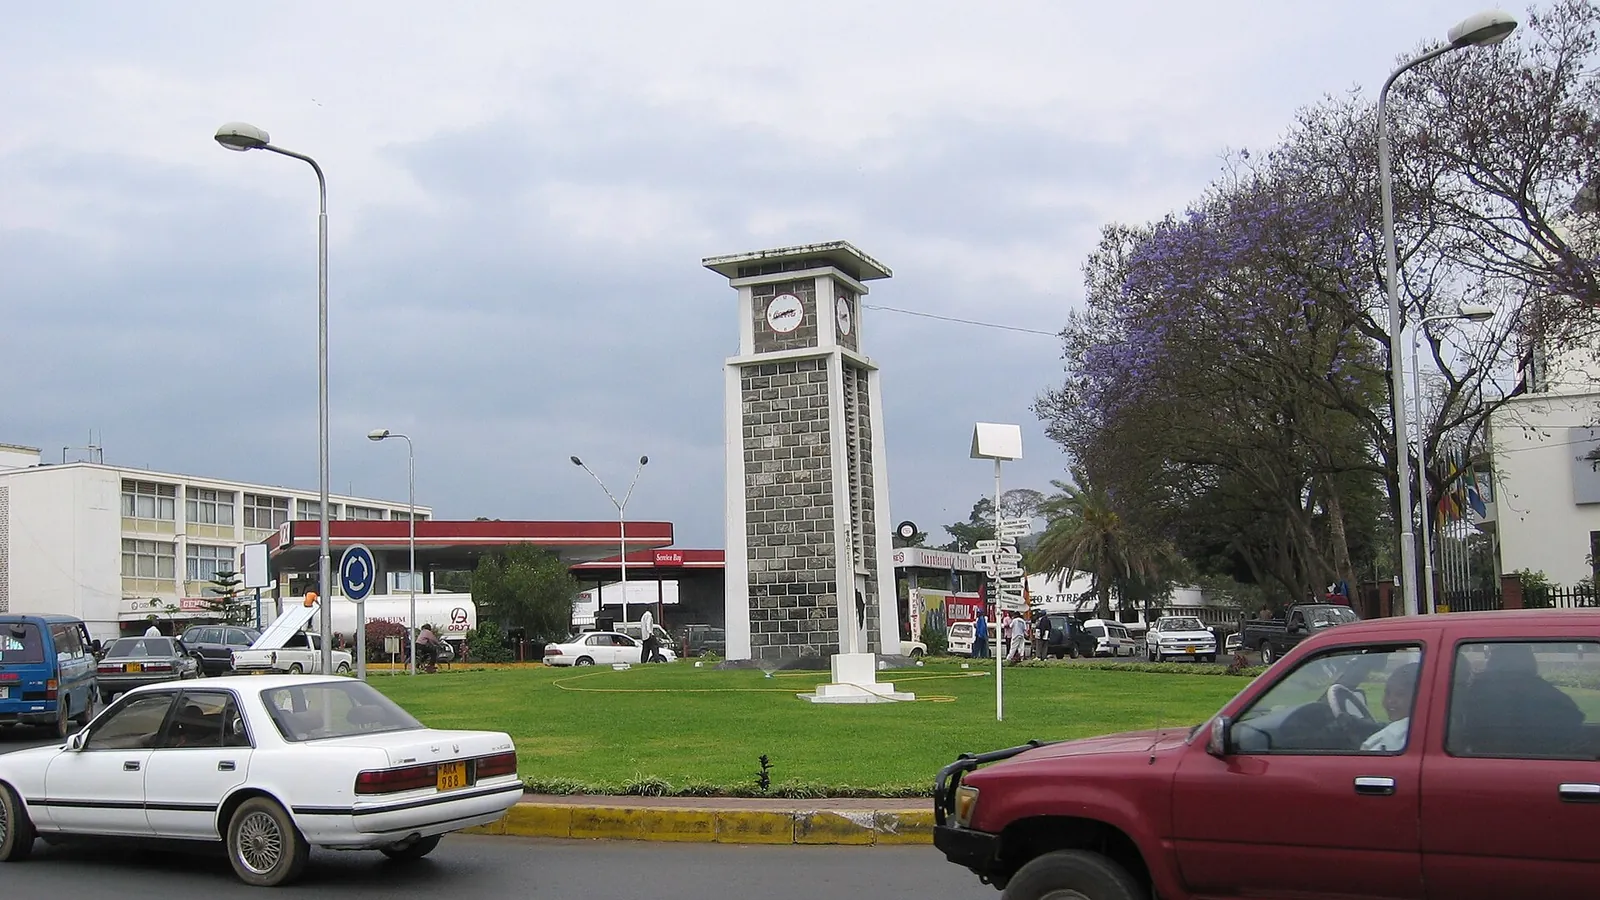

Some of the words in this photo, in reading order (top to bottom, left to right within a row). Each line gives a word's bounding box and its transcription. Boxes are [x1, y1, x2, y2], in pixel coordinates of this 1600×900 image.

[655, 553, 672, 562] Service
[673, 553, 682, 563] Bay
[1045, 594, 1054, 603] &
[365, 615, 406, 624] ETROLEUM
[448, 624, 471, 632] ORYX
[441, 774, 459, 789] 988
